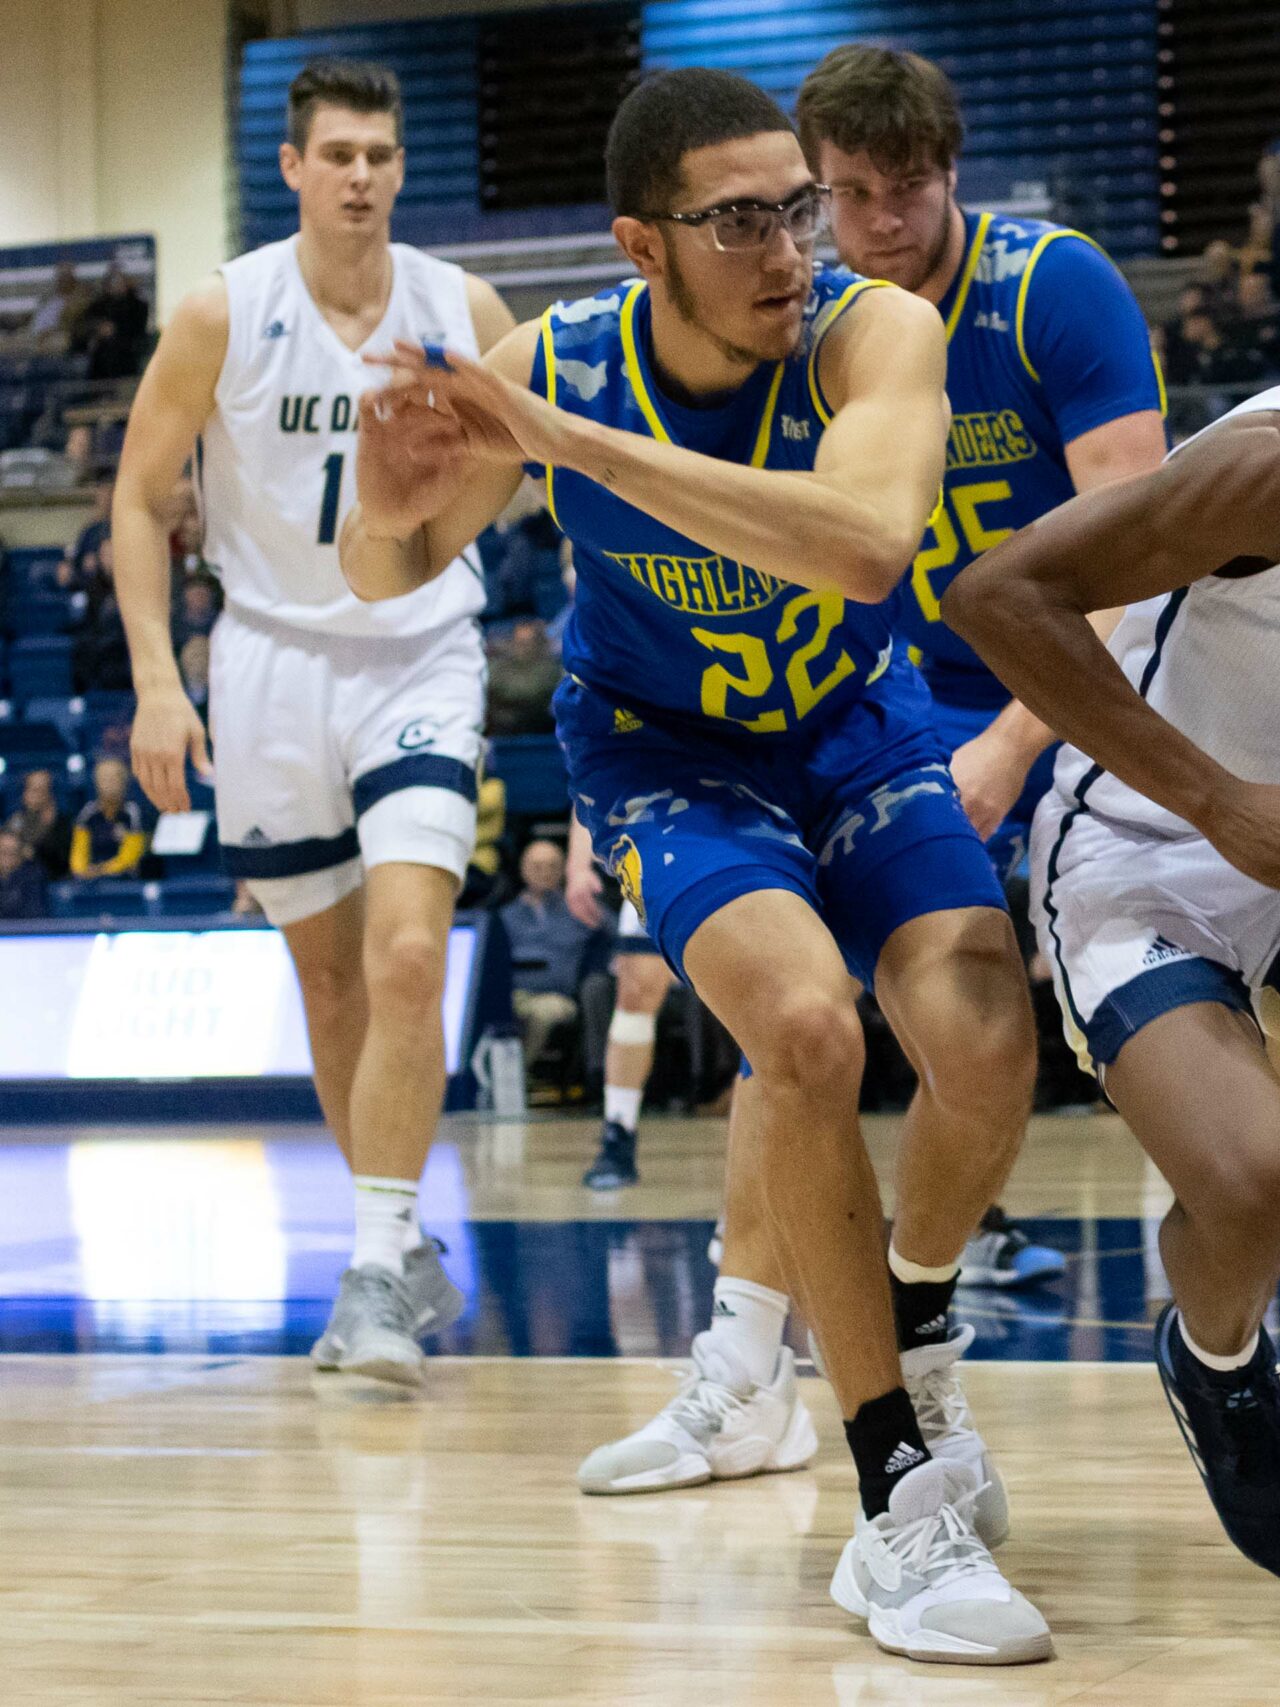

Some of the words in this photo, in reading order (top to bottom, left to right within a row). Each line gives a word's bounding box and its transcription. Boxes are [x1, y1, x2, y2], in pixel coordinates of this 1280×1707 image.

[279, 395, 321, 433] UC
[330, 395, 361, 433] D
[318, 452, 344, 544] 1
[606, 551, 790, 616] IGHLA
[690, 583, 856, 733] 22
[884, 1450, 926, 1474] adidas
